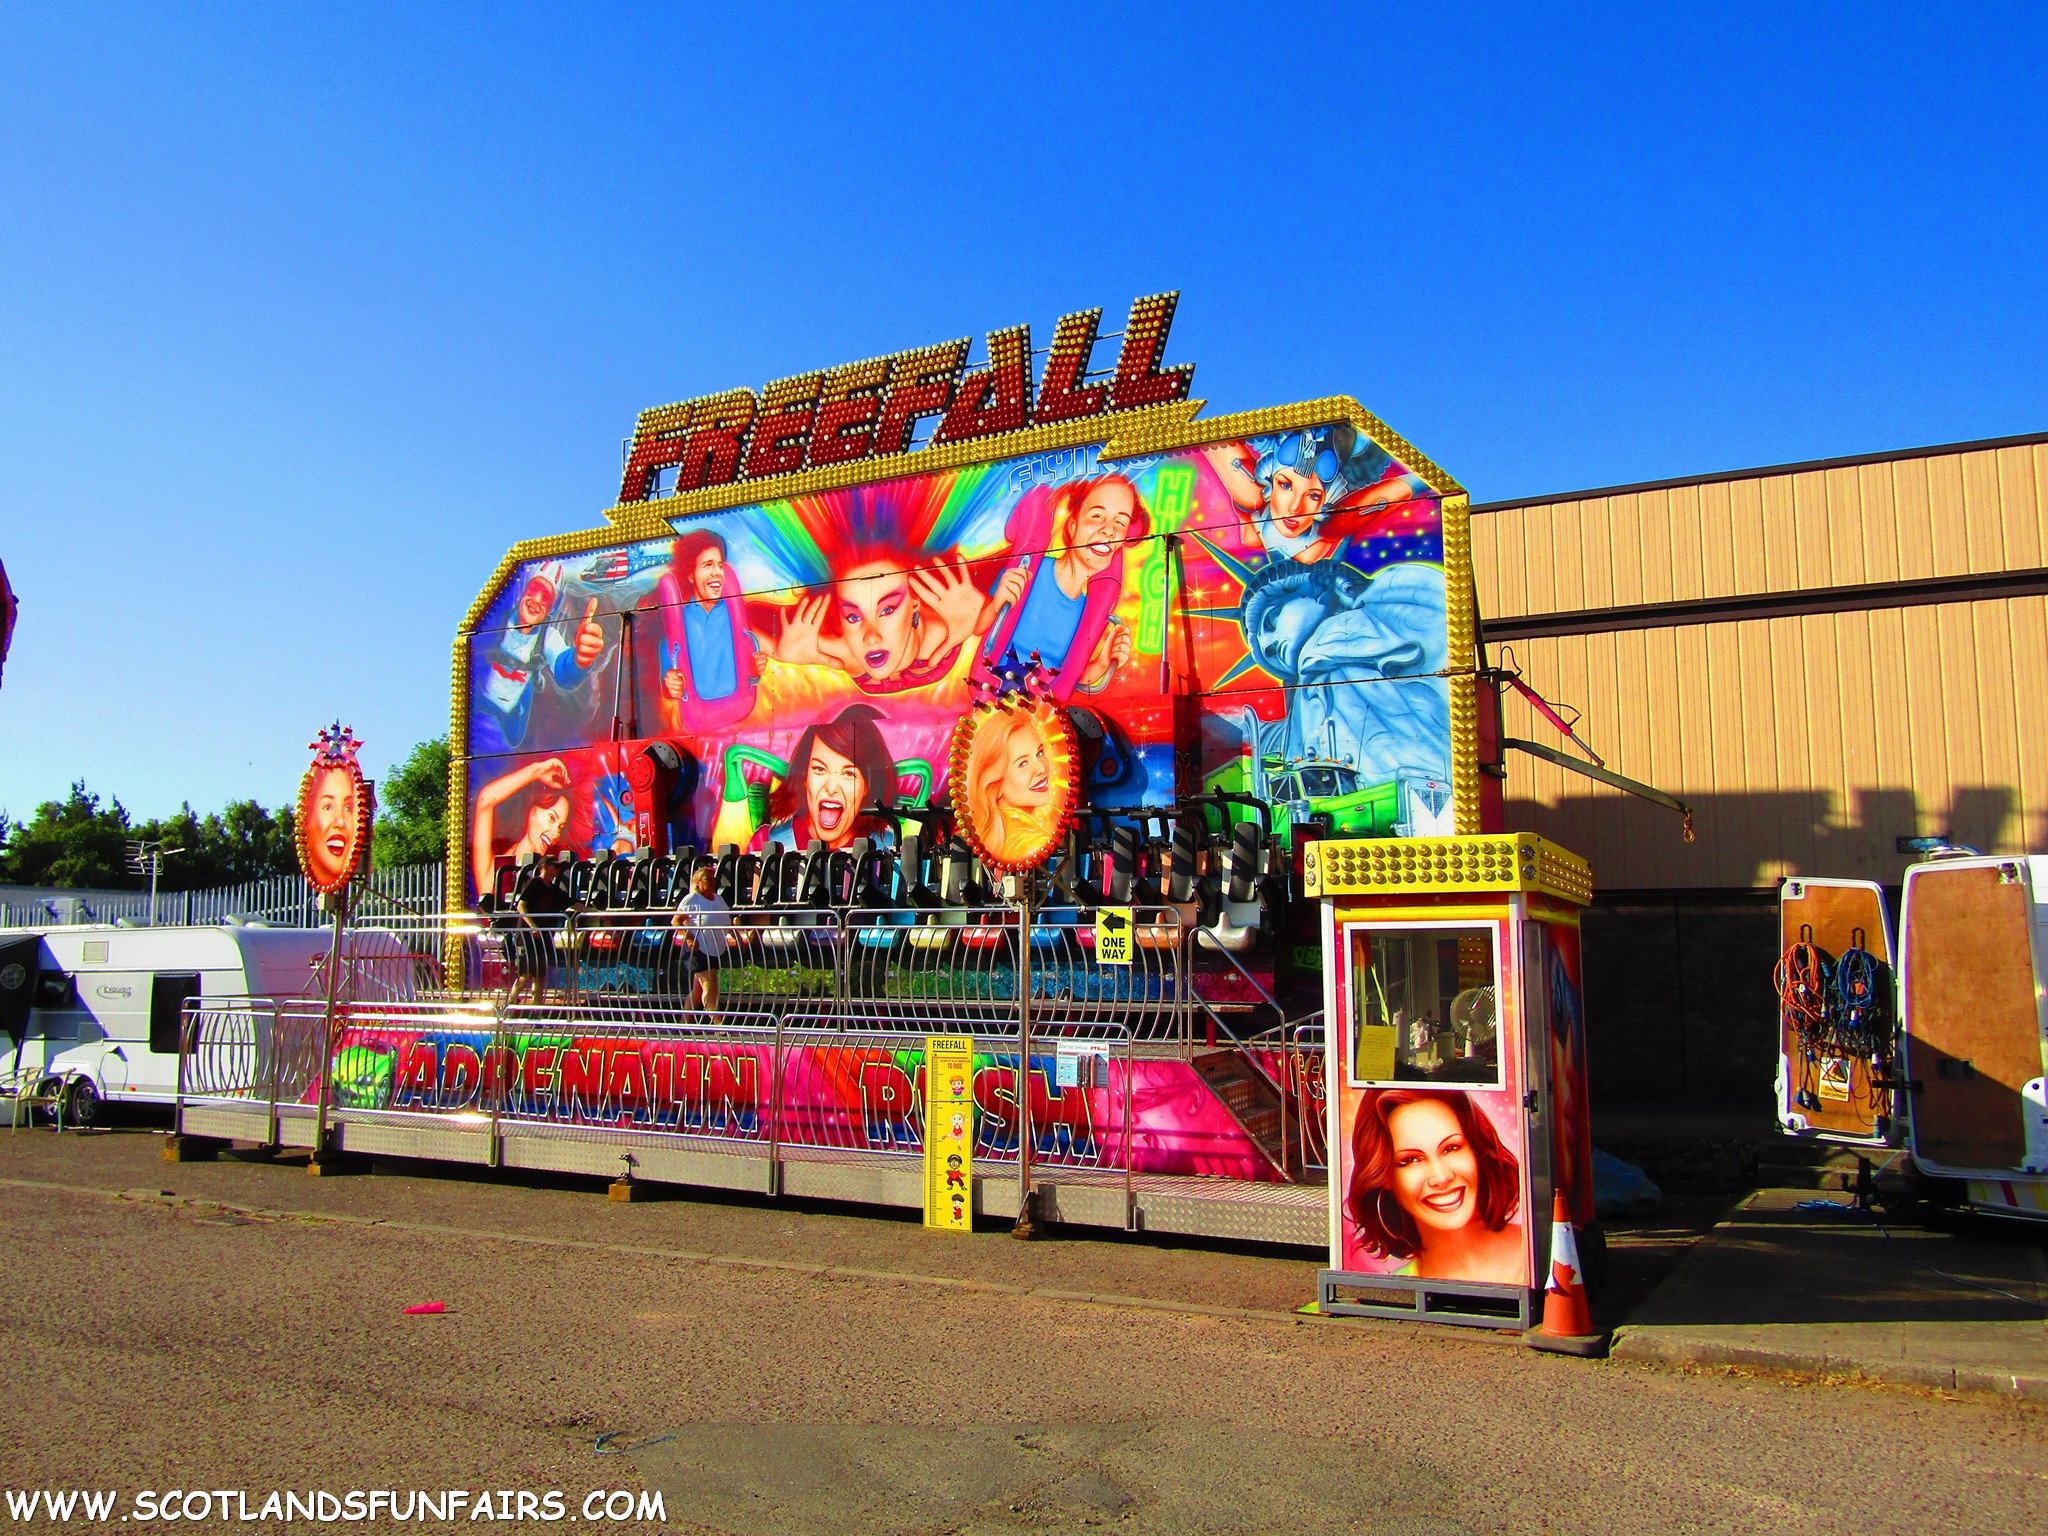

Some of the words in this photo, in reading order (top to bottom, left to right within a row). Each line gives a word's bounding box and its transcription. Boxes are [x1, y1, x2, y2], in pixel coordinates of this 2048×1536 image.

[616, 290, 1196, 504] FREEFALL
[1142, 470, 1193, 649] HIGH
[1102, 937, 1125, 948] ONE
[1102, 949, 1125, 960] WAY
[932, 1040, 967, 1050] FREEFALL
[859, 1062, 1098, 1159] RSH
